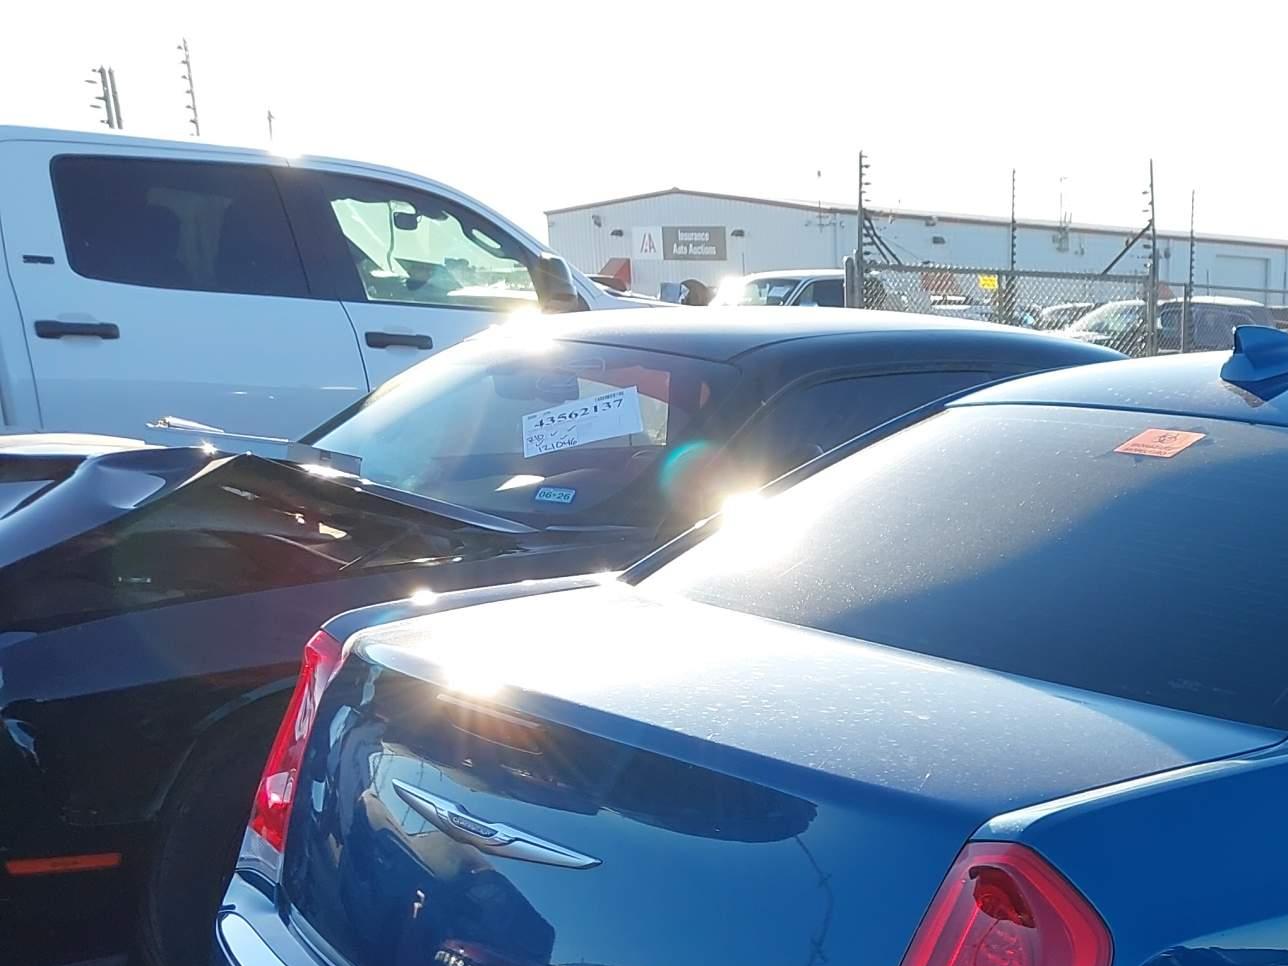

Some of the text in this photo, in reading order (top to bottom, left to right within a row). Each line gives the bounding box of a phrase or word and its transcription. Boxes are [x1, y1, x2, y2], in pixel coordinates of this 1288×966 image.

[678, 229, 710, 242] Insurance
[673, 243, 717, 255] Auto Auctions
[534, 398, 624, 429] 43562137
